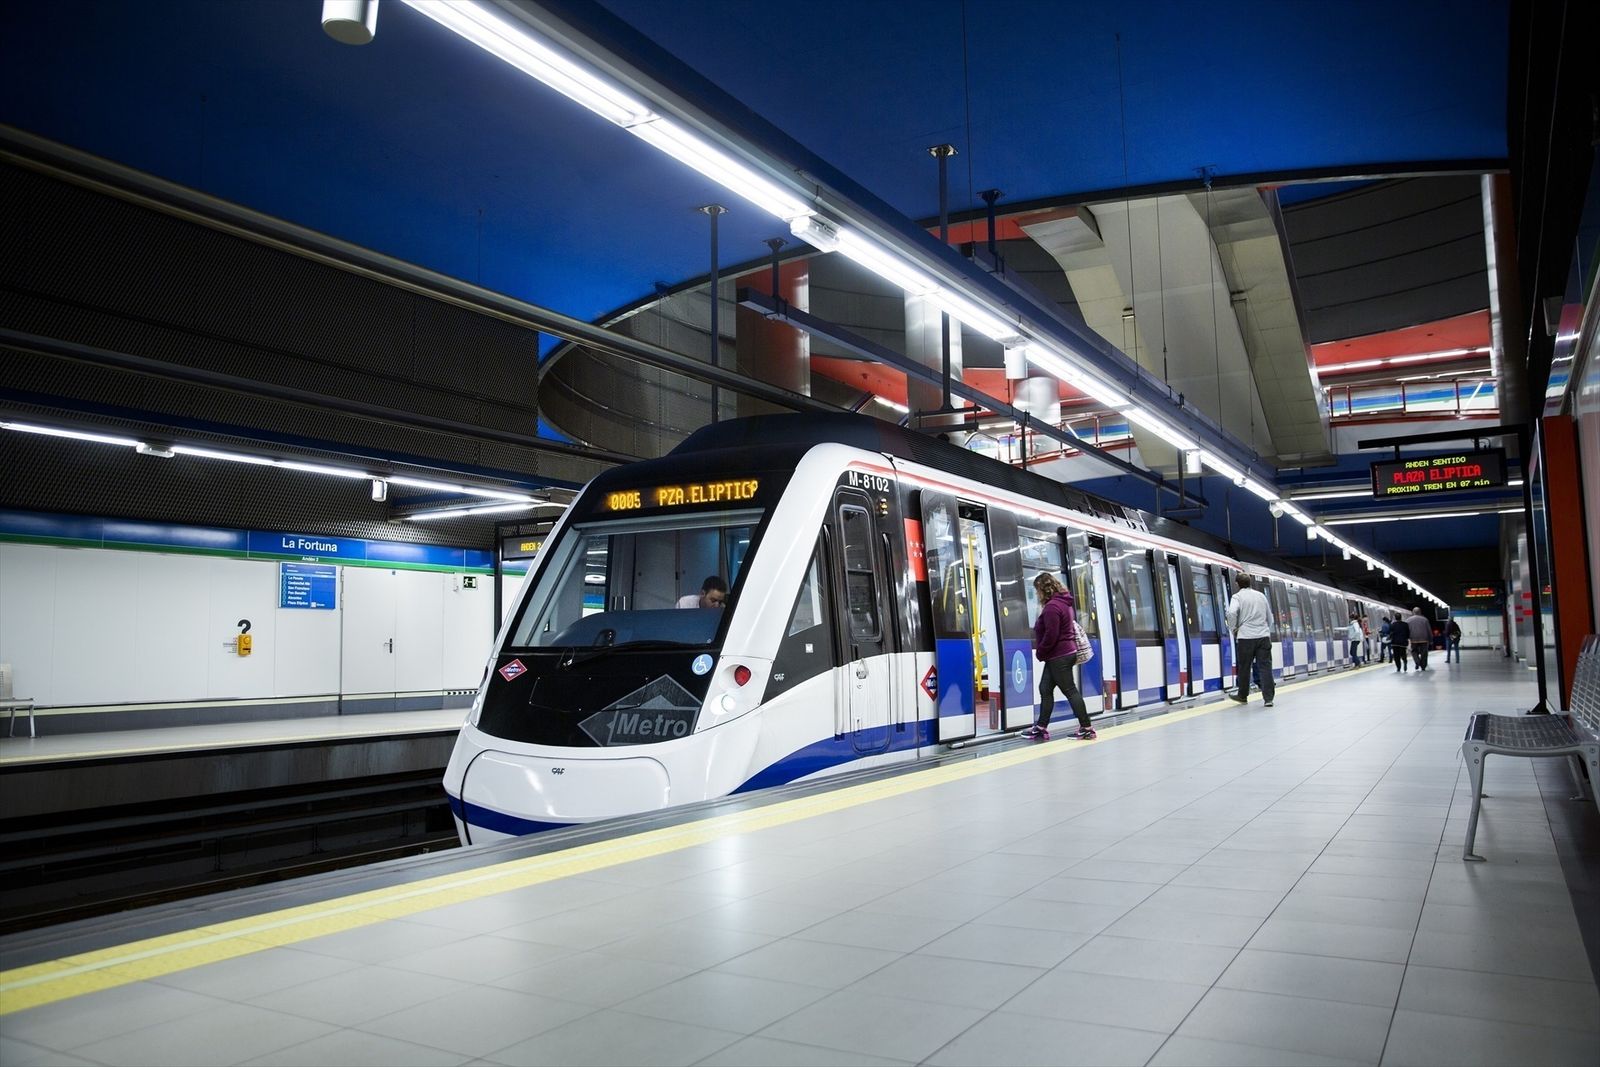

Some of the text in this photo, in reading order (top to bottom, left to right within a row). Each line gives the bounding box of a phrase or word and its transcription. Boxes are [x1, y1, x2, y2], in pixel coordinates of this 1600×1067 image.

[1405, 456, 1466, 469] ANDEN SENTIDO
[848, 470, 890, 493] M-8102
[1393, 465, 1481, 484] PLAZA ELIPTICA
[1387, 485, 1420, 494] PROXIMO
[1446, 481, 1457, 489] EN
[1474, 478, 1490, 486] min
[611, 492, 642, 511] 0005
[282, 537, 338, 552] La Fortuna
[616, 714, 688, 737] Metro
